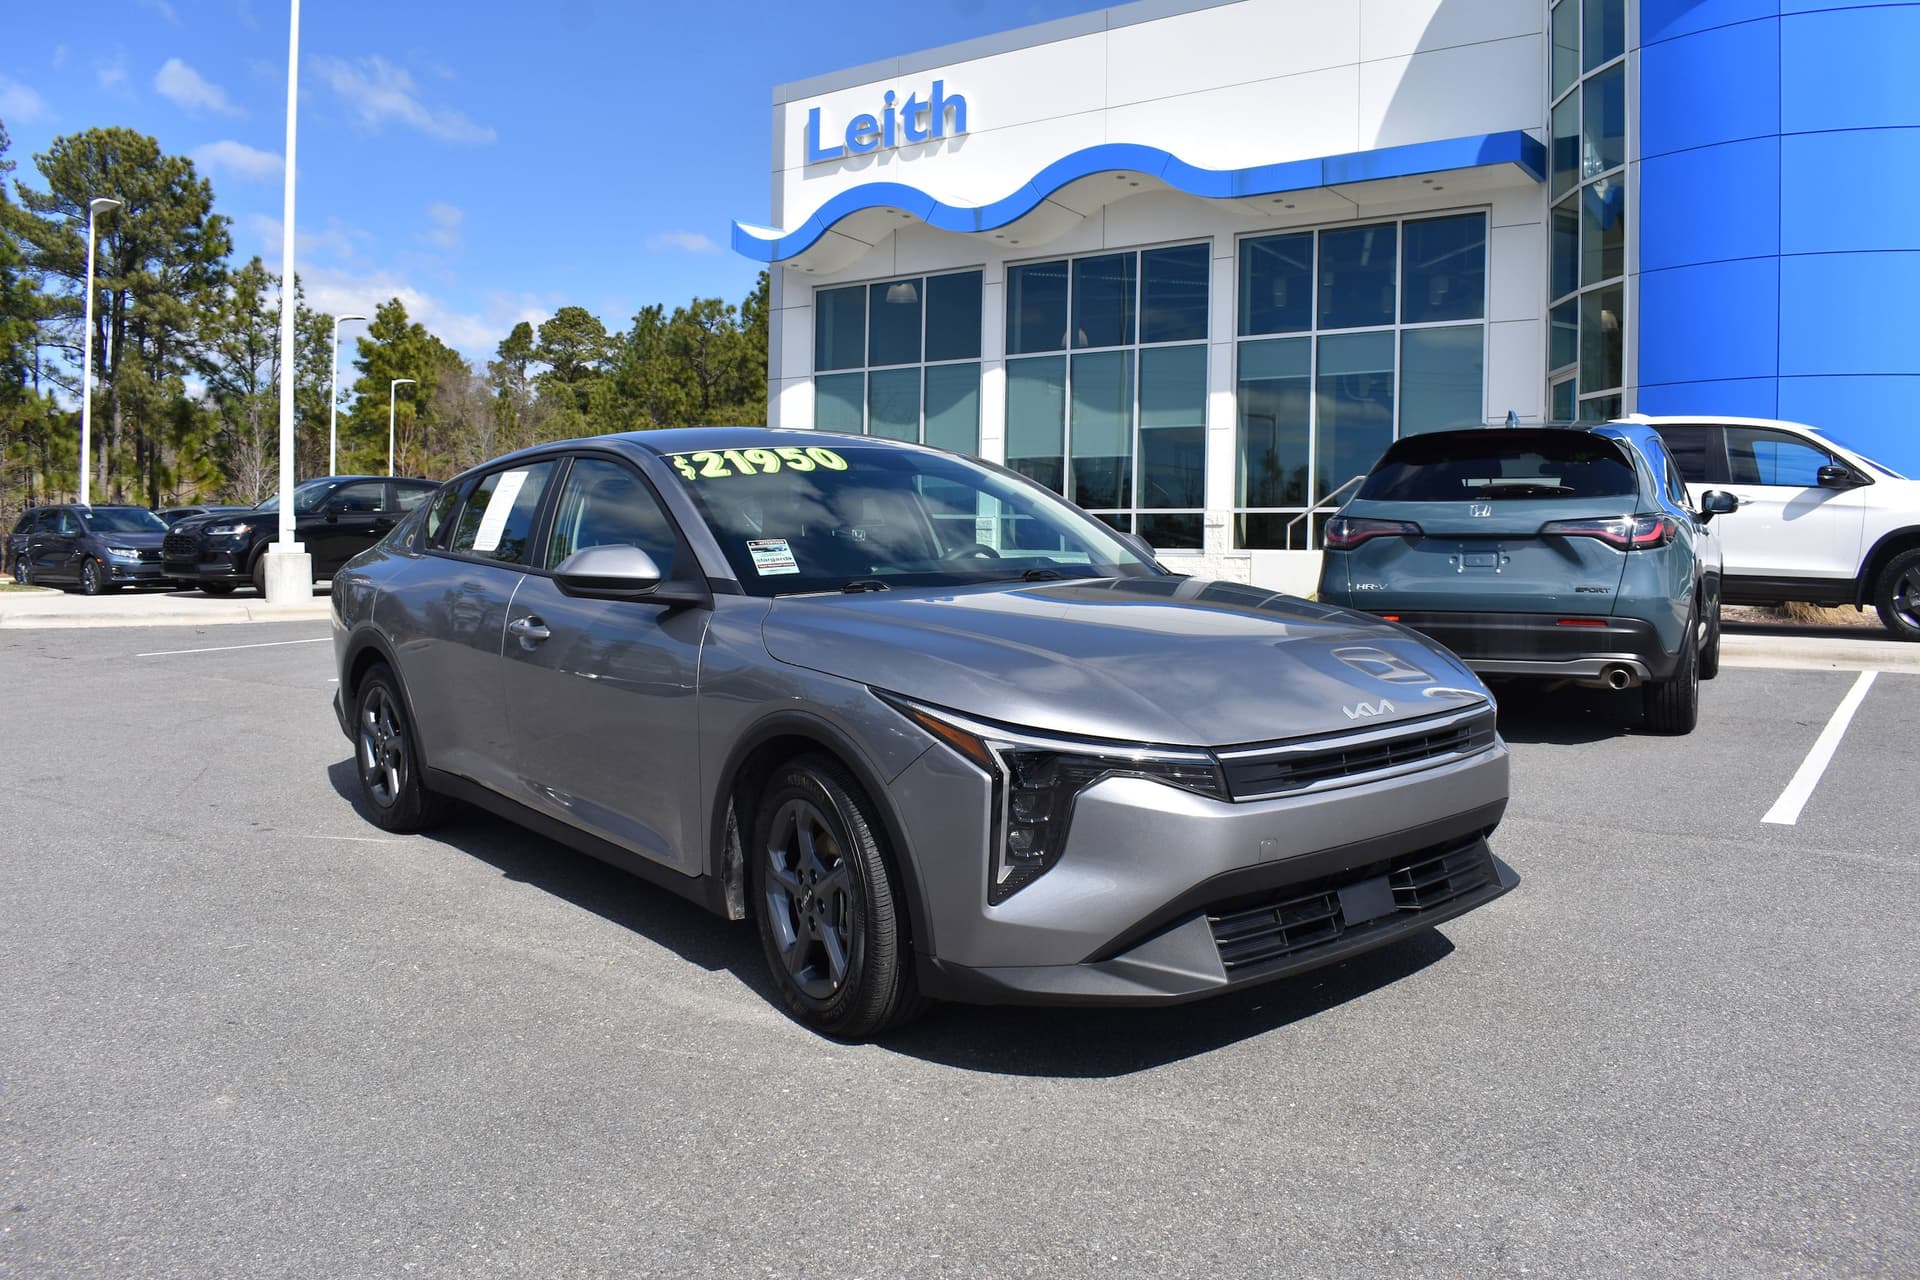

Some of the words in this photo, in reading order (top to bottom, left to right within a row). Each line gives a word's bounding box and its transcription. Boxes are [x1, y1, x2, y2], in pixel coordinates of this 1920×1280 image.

[809, 80, 967, 163] Leith
[673, 447, 849, 481] $21950
[1342, 699, 1395, 720] KIA
